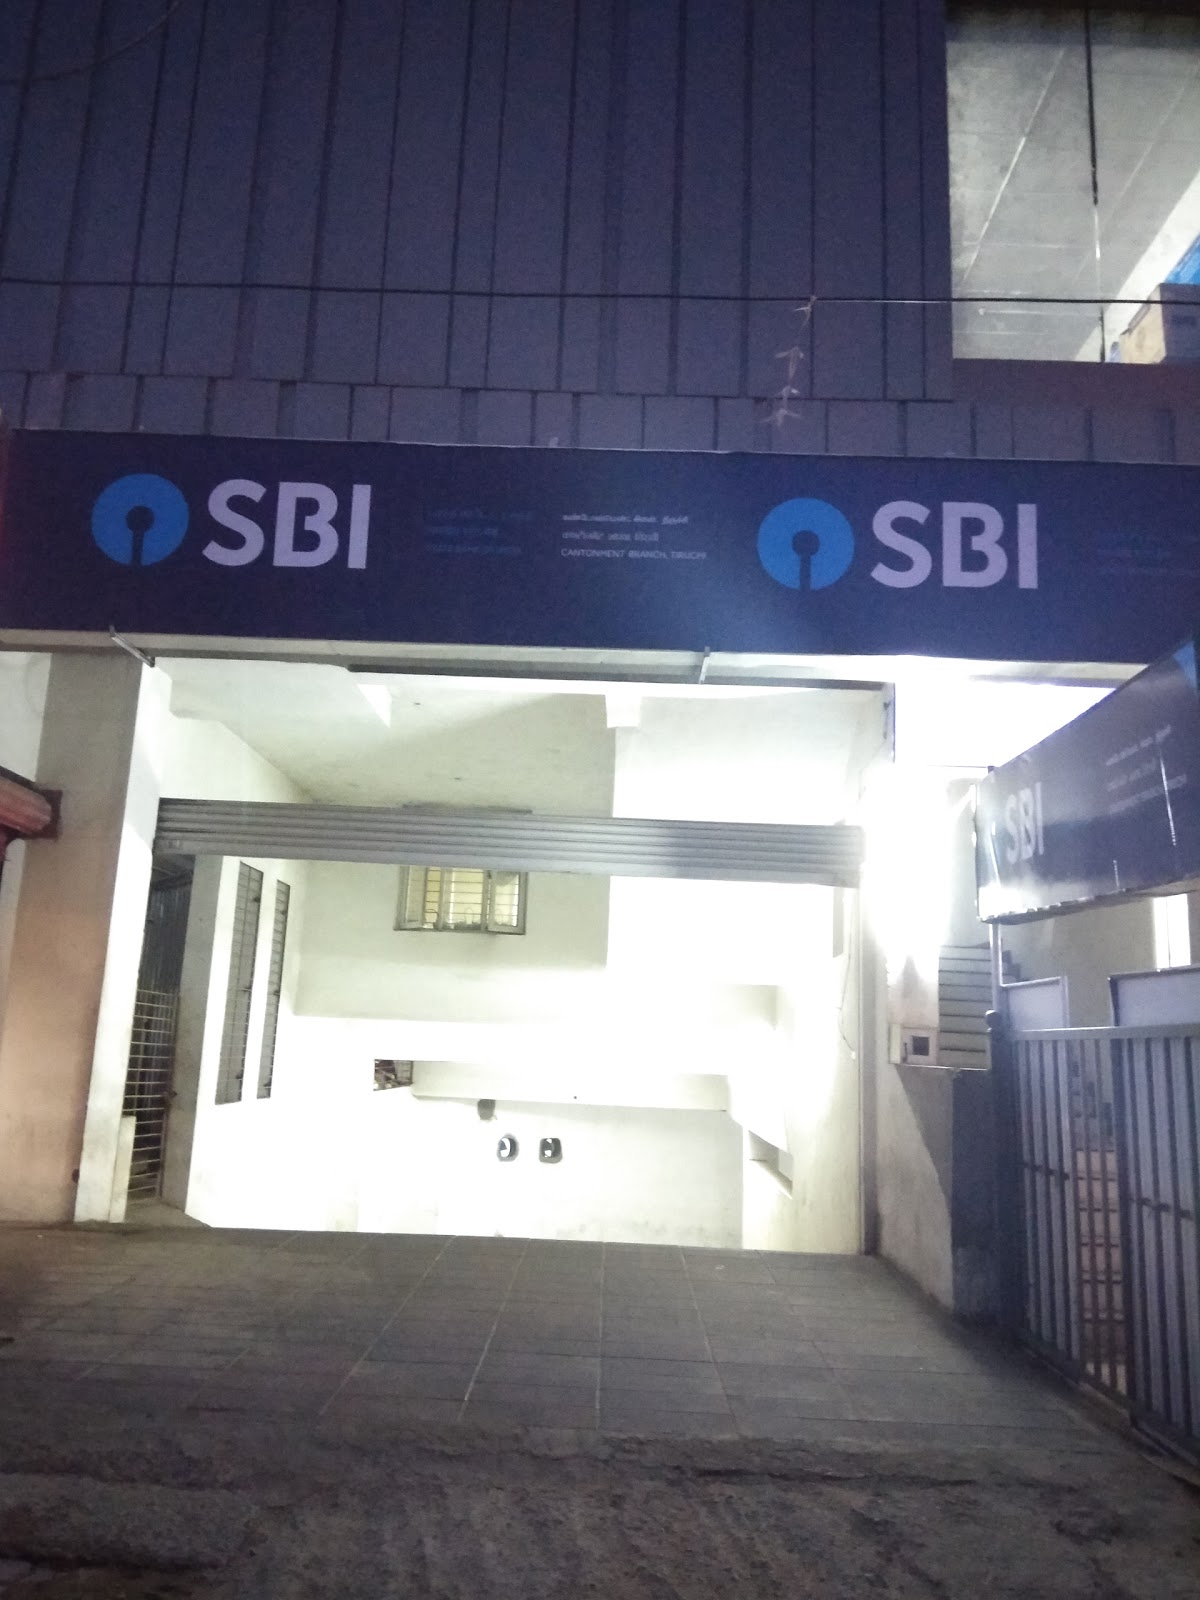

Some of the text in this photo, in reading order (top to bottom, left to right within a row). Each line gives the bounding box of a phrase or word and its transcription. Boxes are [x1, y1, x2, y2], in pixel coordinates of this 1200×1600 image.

[202, 478, 371, 569] SBI
[560, 548, 625, 558] CANTONMENT
[870, 499, 1038, 589] SBI
[1004, 781, 1045, 865] SBI
